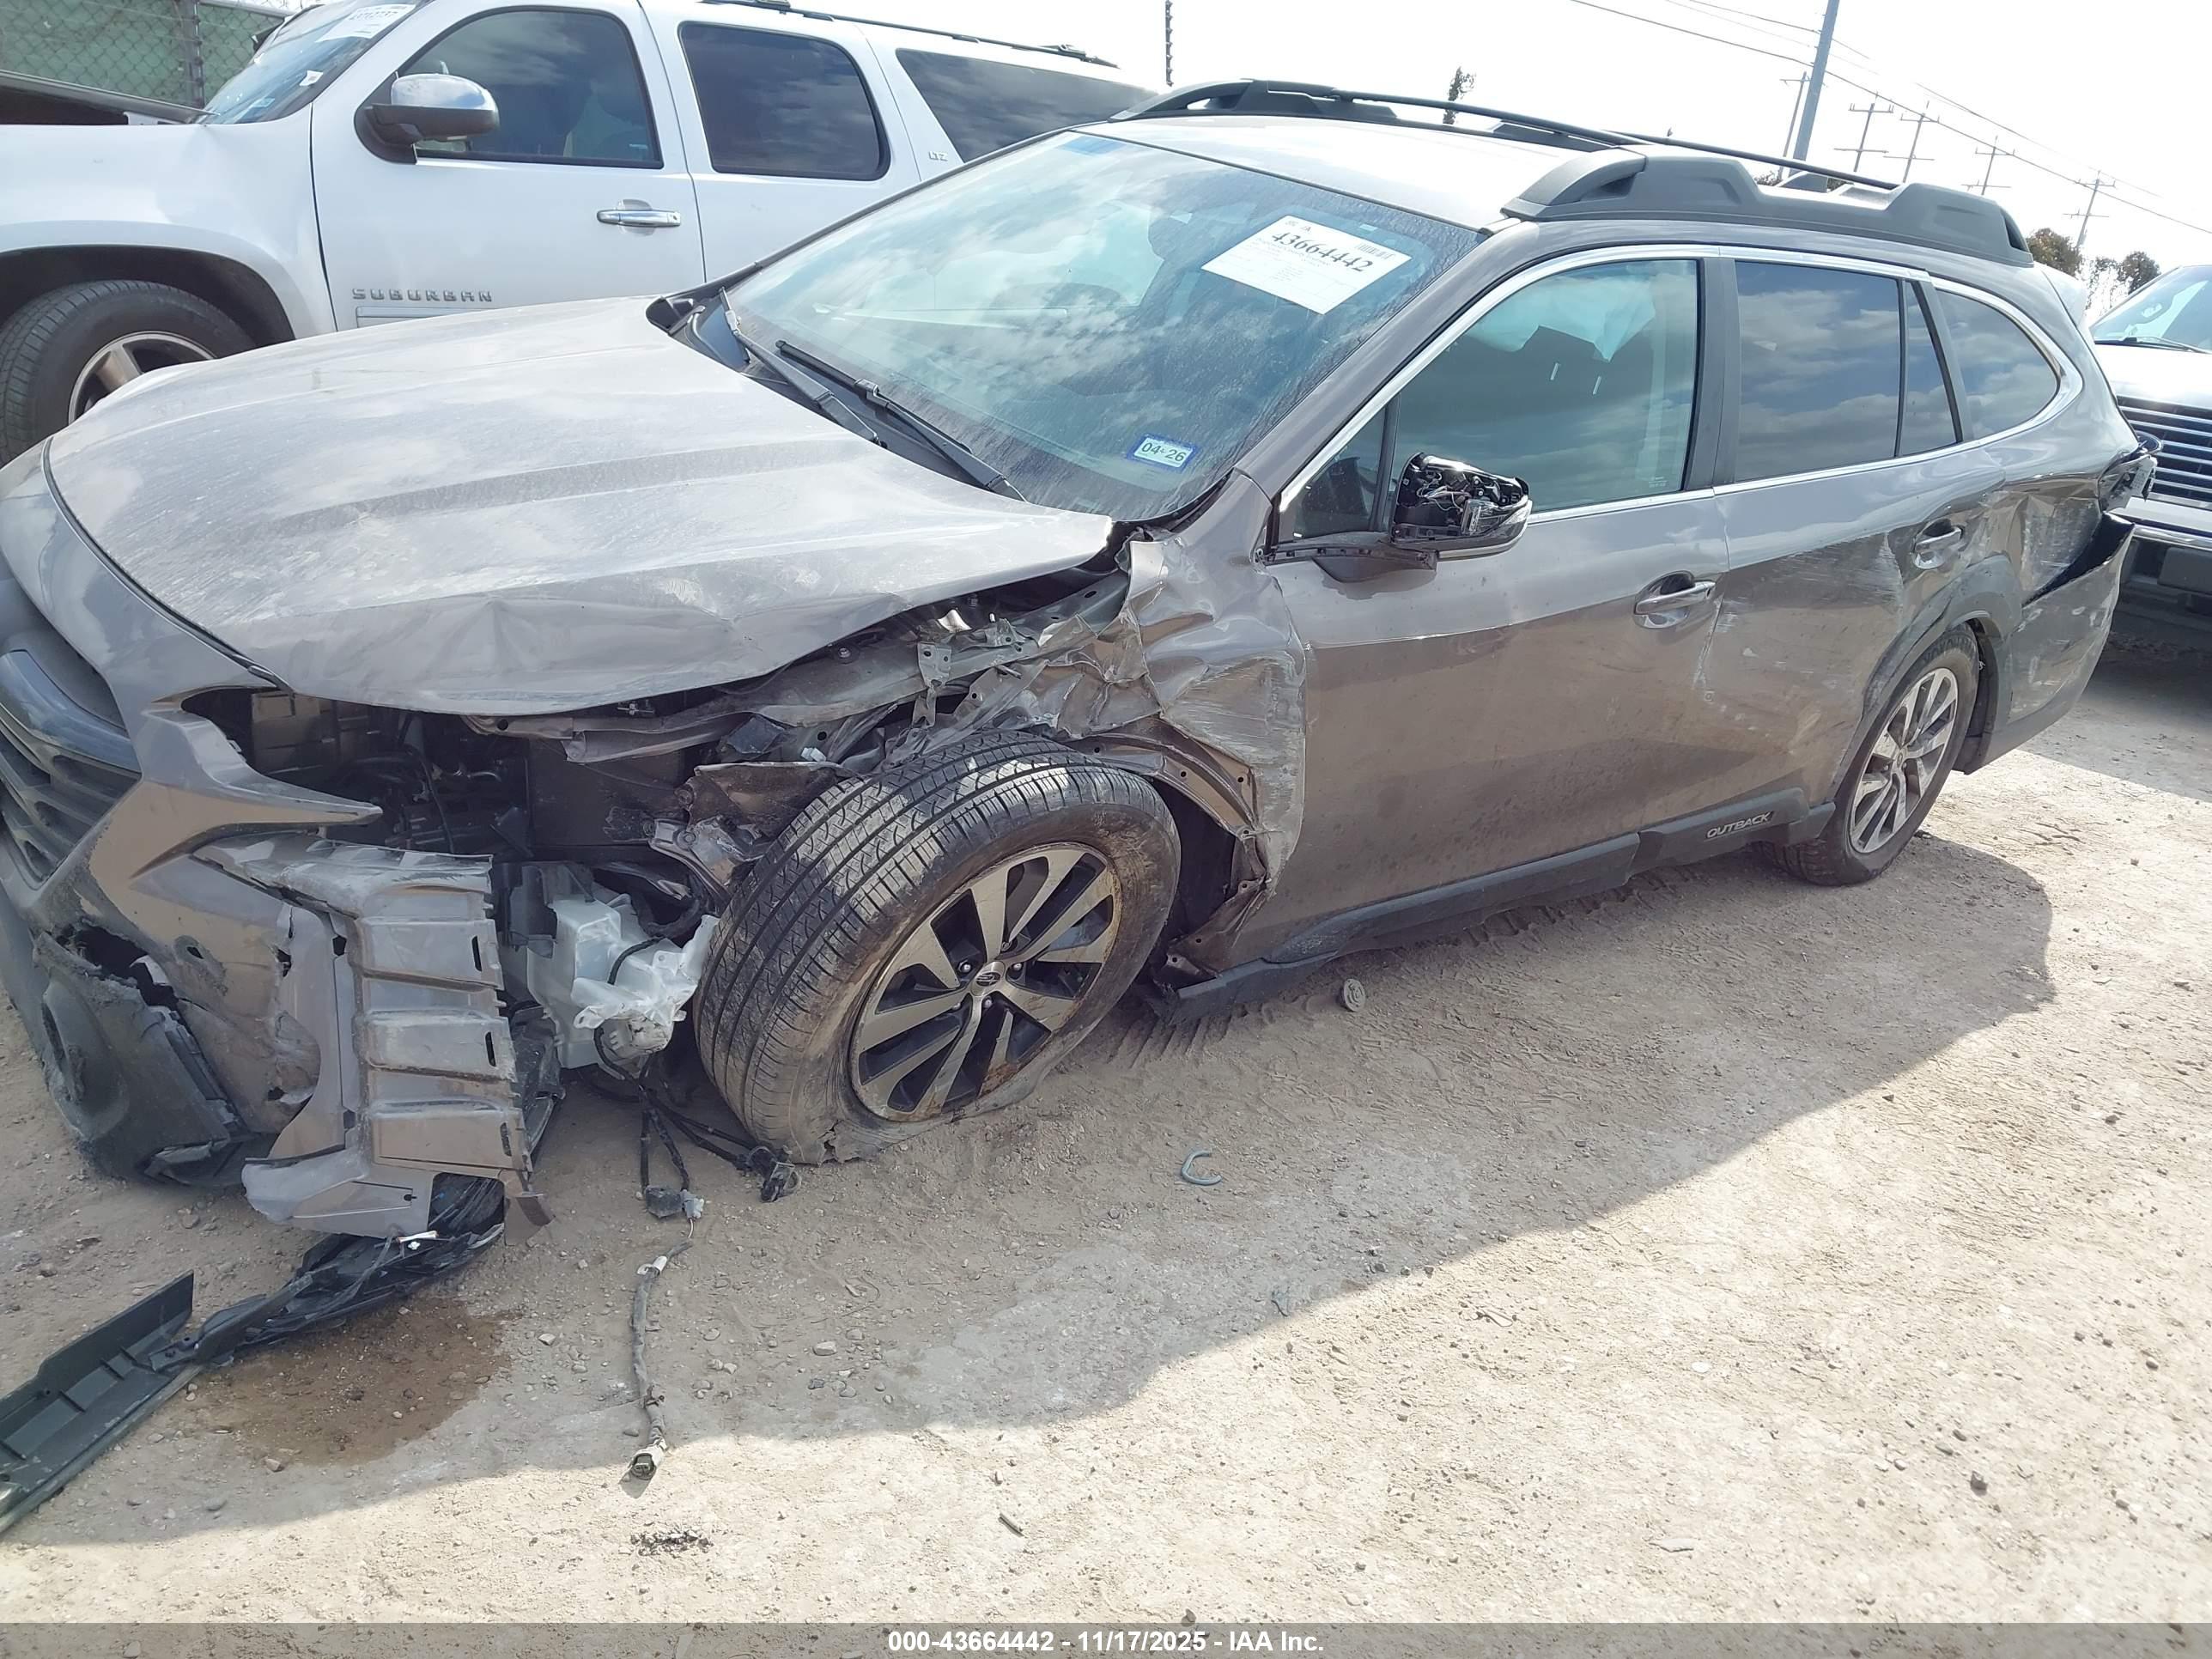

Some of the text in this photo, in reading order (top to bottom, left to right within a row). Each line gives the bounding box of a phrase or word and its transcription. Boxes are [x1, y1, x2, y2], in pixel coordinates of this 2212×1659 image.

[928, 151, 948, 162] LTZ
[1272, 232, 1374, 272] 43664442
[351, 288, 493, 302] SUBURBAN
[1141, 442, 1188, 462] 04 26
[1706, 811, 1772, 838] OUTBACK
